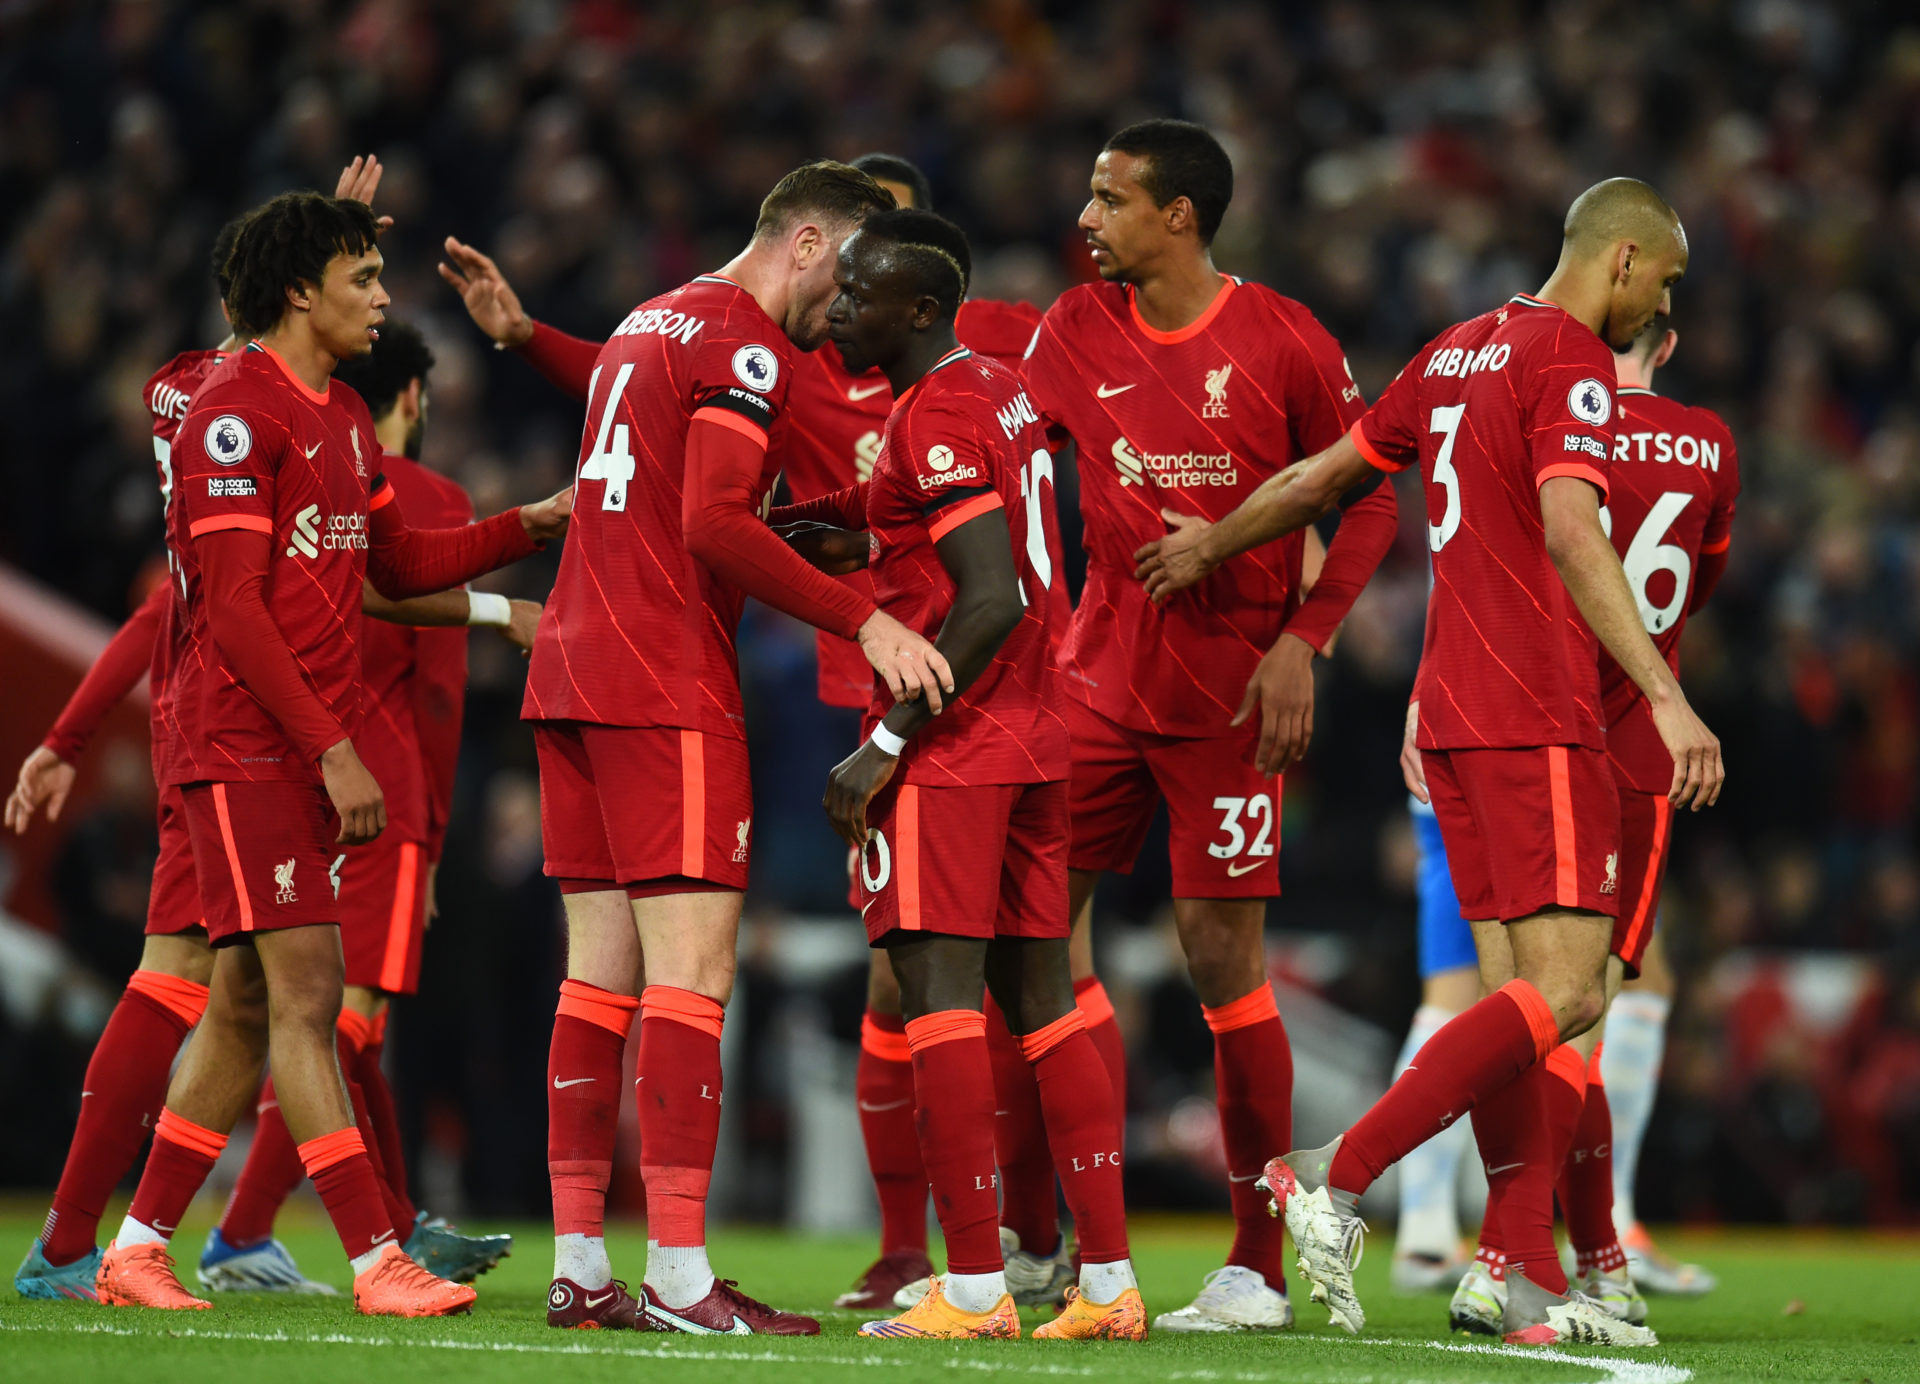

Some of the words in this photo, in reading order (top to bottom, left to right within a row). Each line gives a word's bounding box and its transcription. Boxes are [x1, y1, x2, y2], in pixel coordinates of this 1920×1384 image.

[152, 381, 191, 420] LUIS
[1564, 434, 1580, 445] No
[1612, 432, 1720, 472] RTSON
[208, 478, 224, 489] No
[225, 479, 252, 488] room
[225, 486, 256, 496] racism
[917, 464, 977, 490] Expedia
[1429, 402, 1467, 553] 3
[1599, 491, 1695, 635] 6
[1207, 793, 1274, 859] 32
